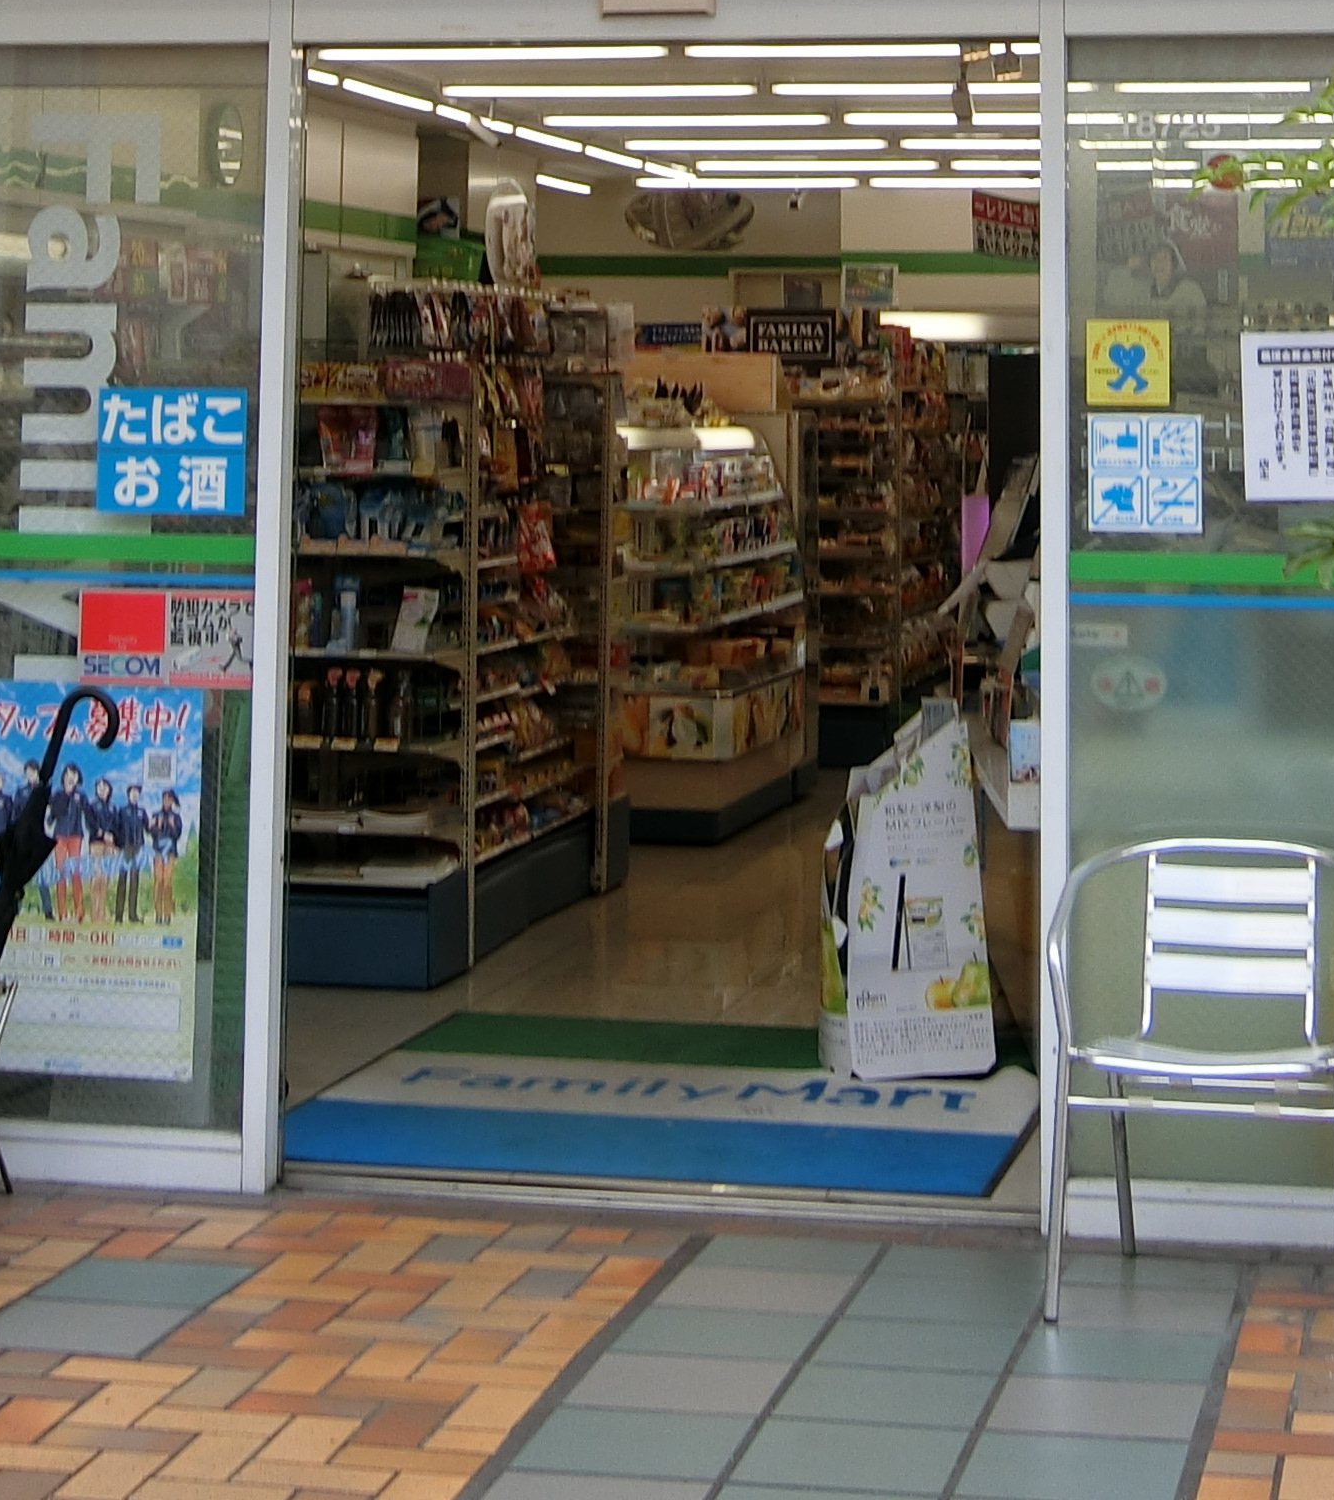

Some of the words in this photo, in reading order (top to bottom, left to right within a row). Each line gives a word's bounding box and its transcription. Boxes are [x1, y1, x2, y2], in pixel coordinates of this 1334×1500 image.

[757, 322, 825, 337] FAMIMA
[757, 338, 824, 352] BAKERY
[101, 393, 244, 446] たばこ
[113, 454, 229, 512] お酒
[83, 654, 161, 677] SECOM
[400, 1066, 978, 1114] FamilyMart
